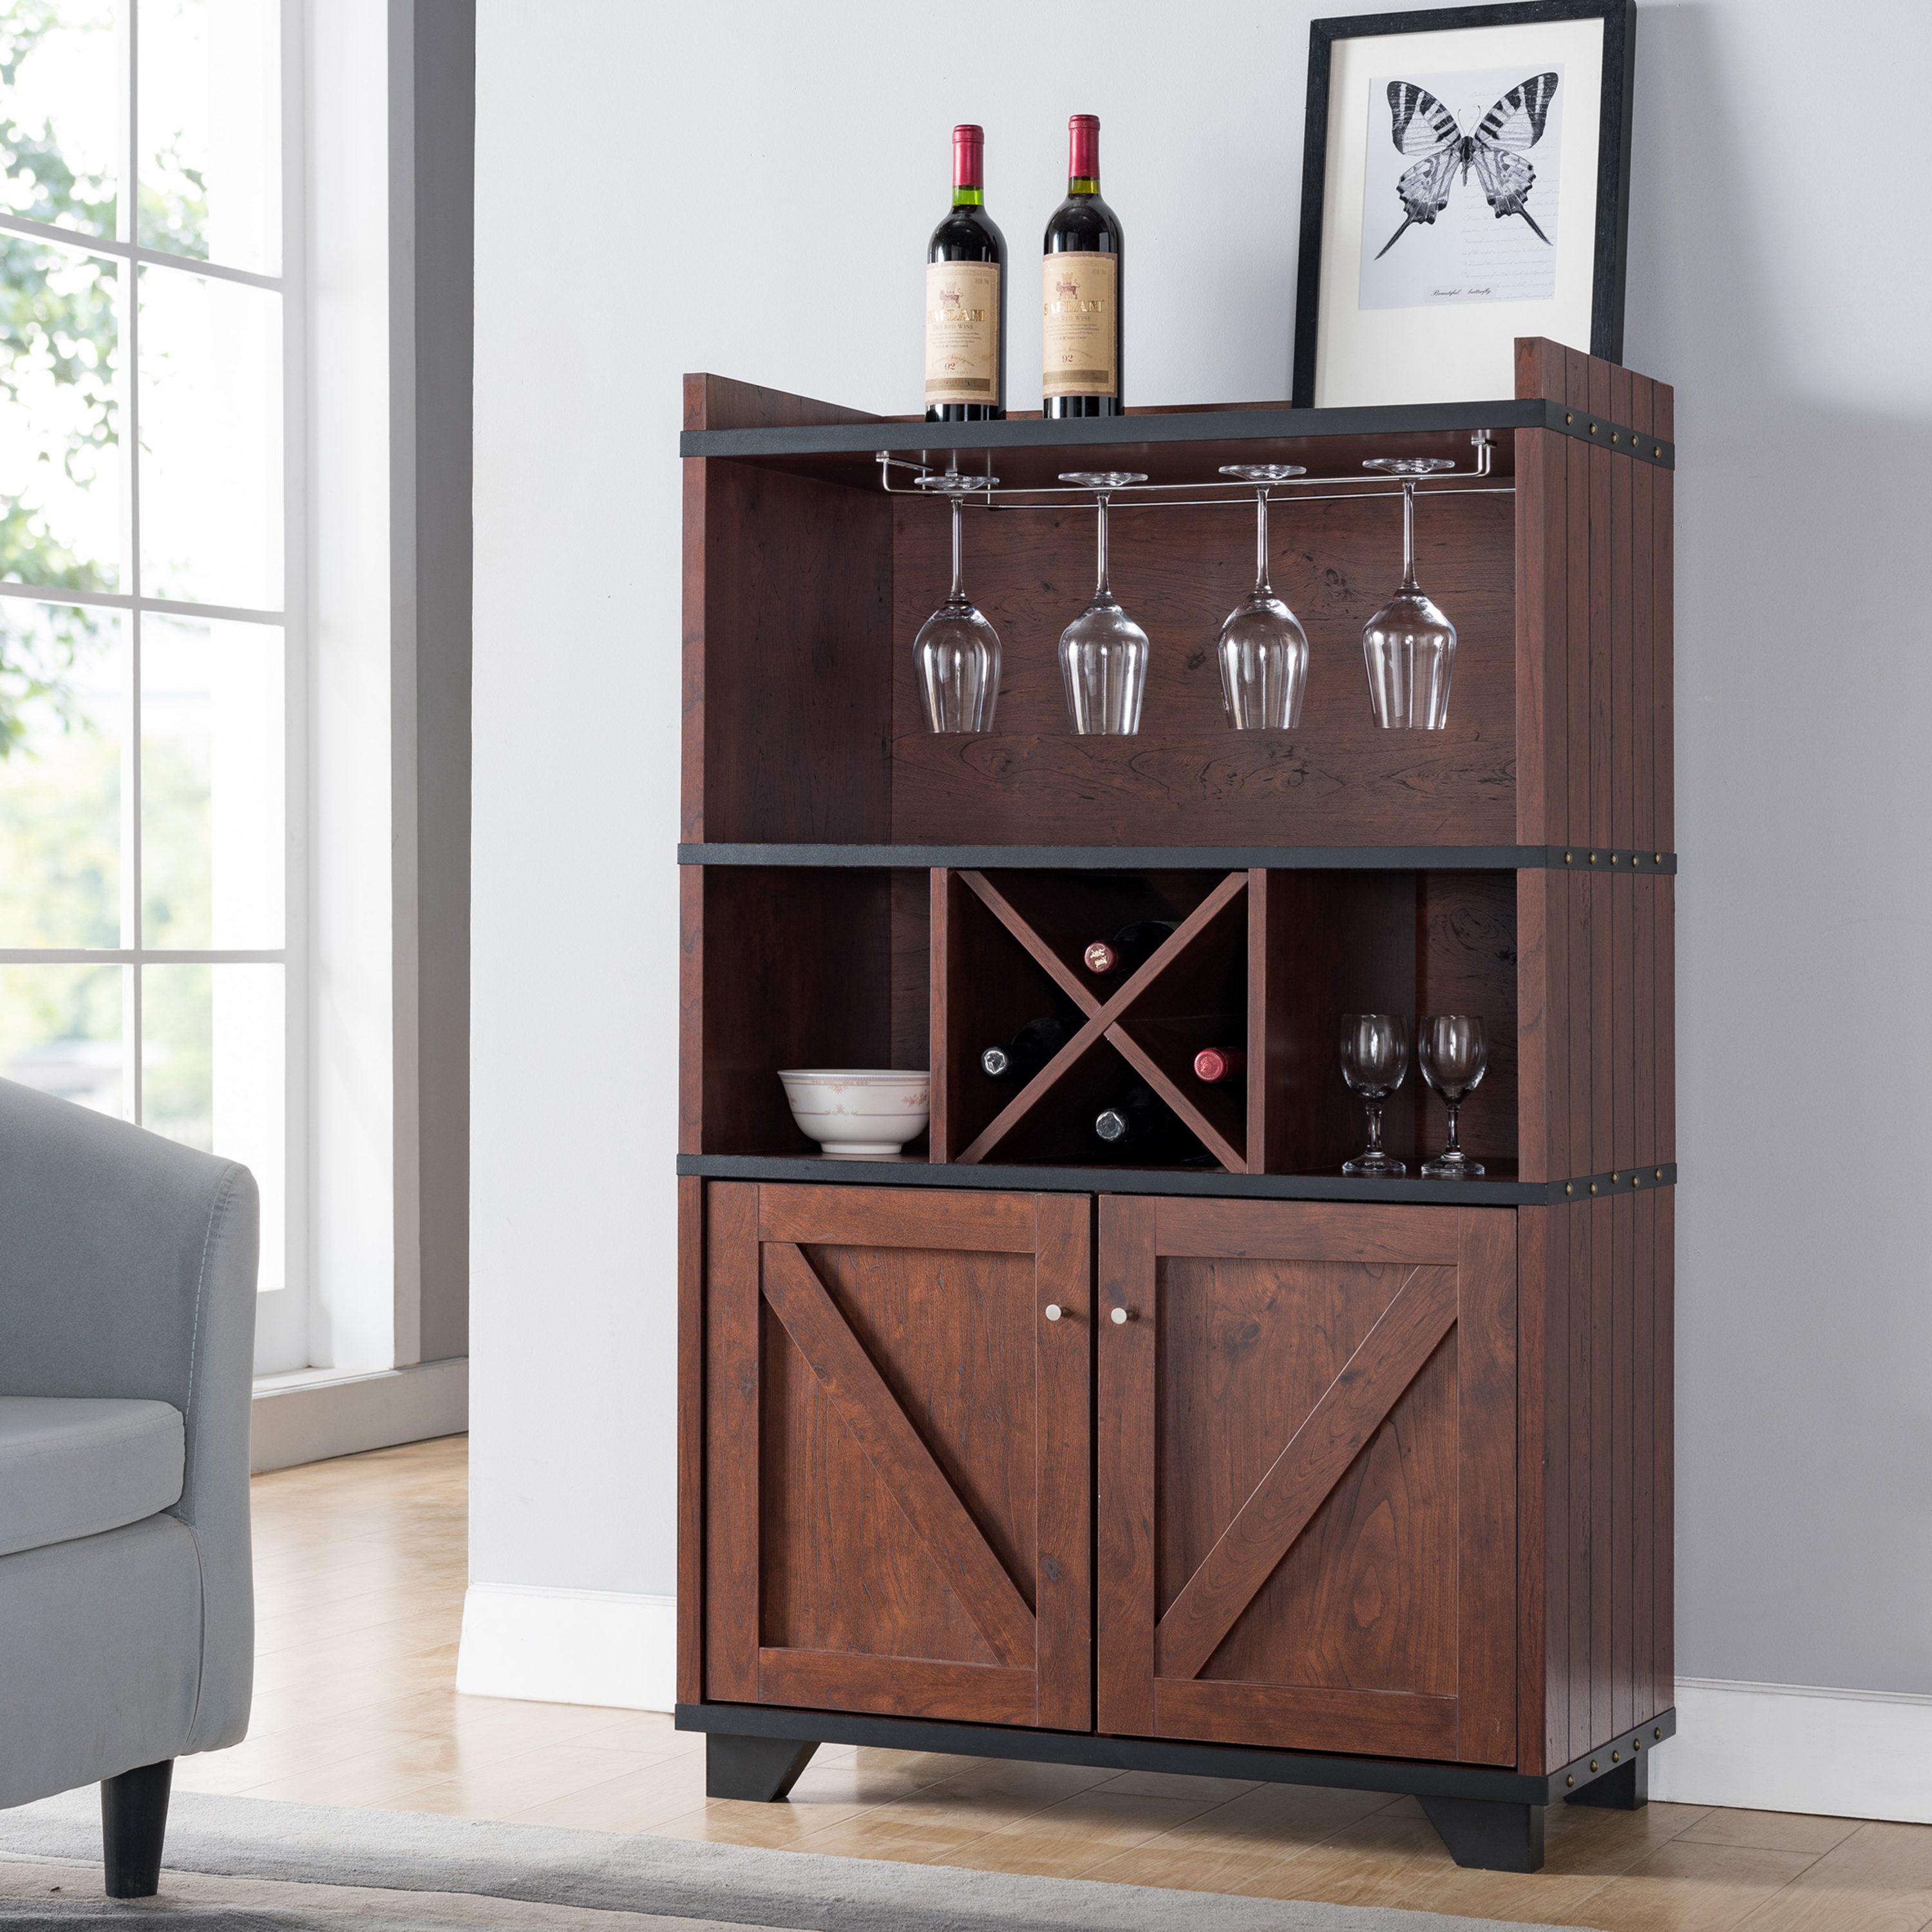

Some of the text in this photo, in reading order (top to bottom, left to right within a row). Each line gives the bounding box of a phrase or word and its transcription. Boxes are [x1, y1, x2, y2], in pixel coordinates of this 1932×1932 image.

[1430, 289, 1462, 297] Beautiful
[1044, 299, 1103, 316] SAFLAM
[927, 308, 985, 323] SAFLAM
[1062, 354, 1074, 363] 92
[945, 362, 956, 370] 92
